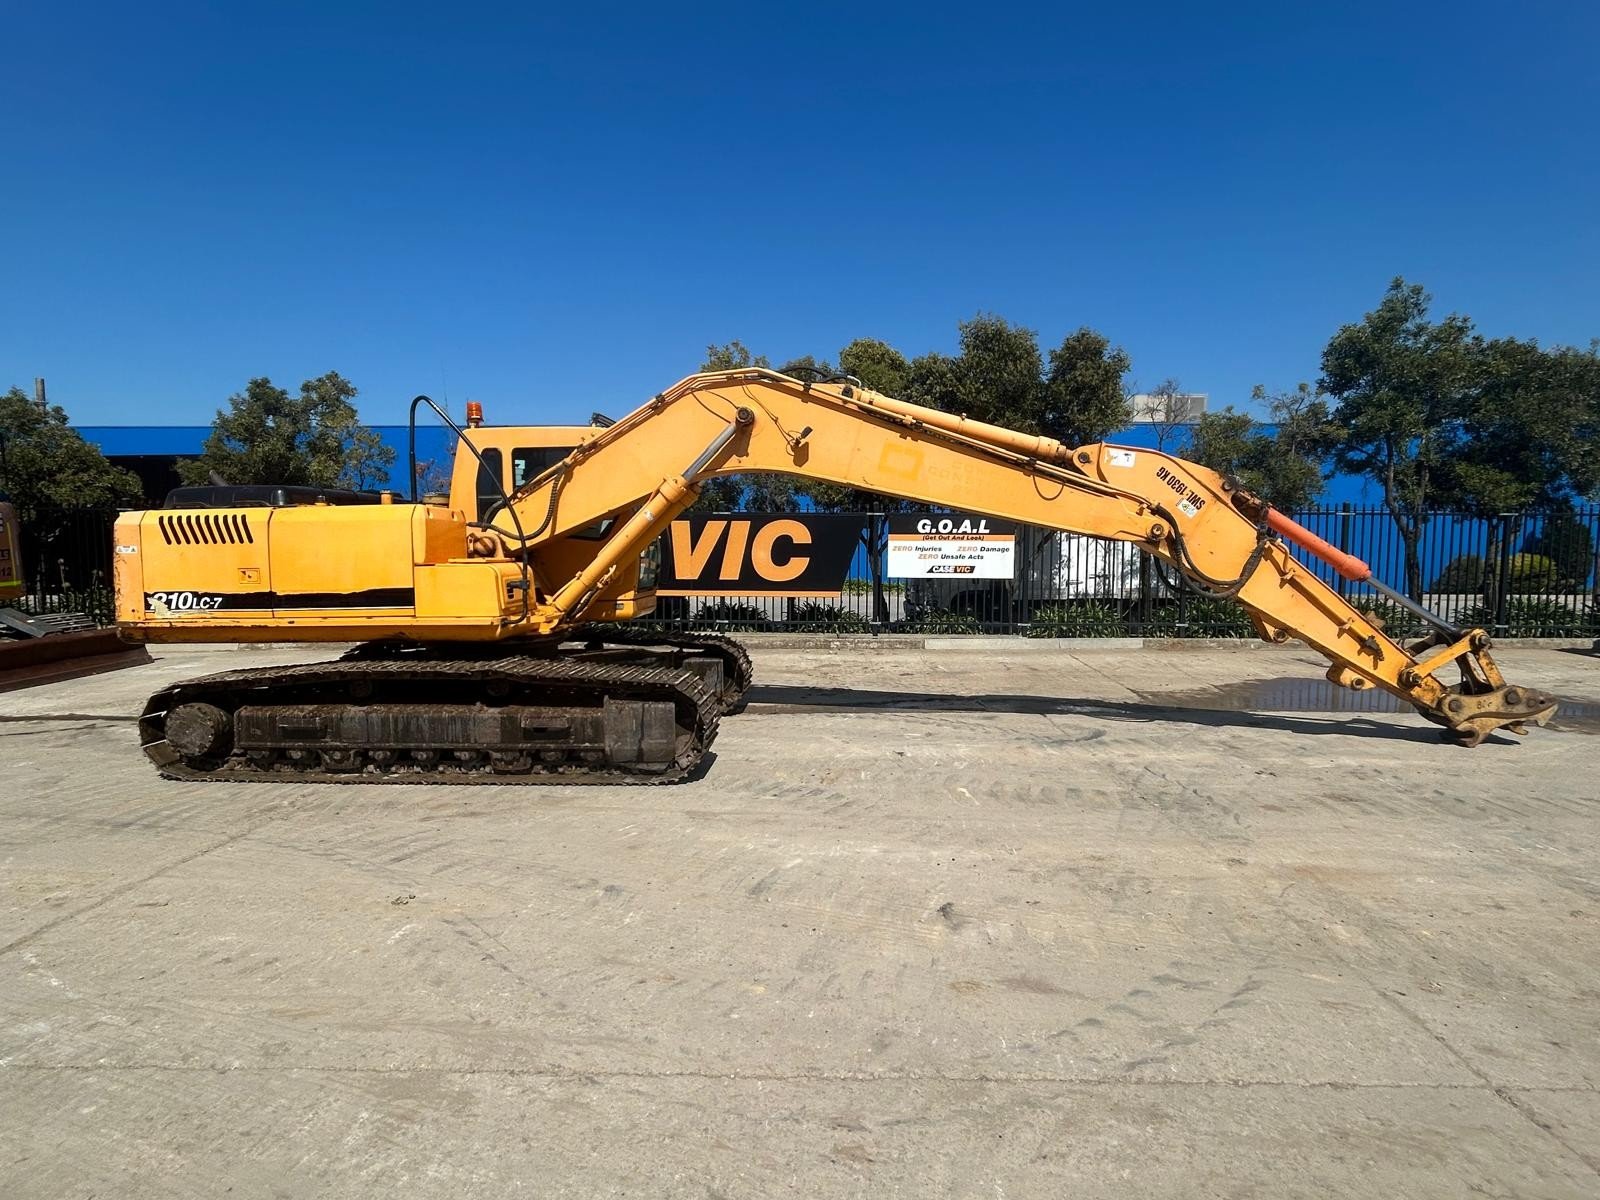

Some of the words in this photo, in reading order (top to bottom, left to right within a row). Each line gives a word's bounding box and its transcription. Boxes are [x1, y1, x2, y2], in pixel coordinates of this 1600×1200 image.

[1156, 466, 1171, 482] KG
[1166, 475, 1188, 496] 1930
[917, 519, 990, 534] G.O.A.L
[670, 519, 813, 582] VIC
